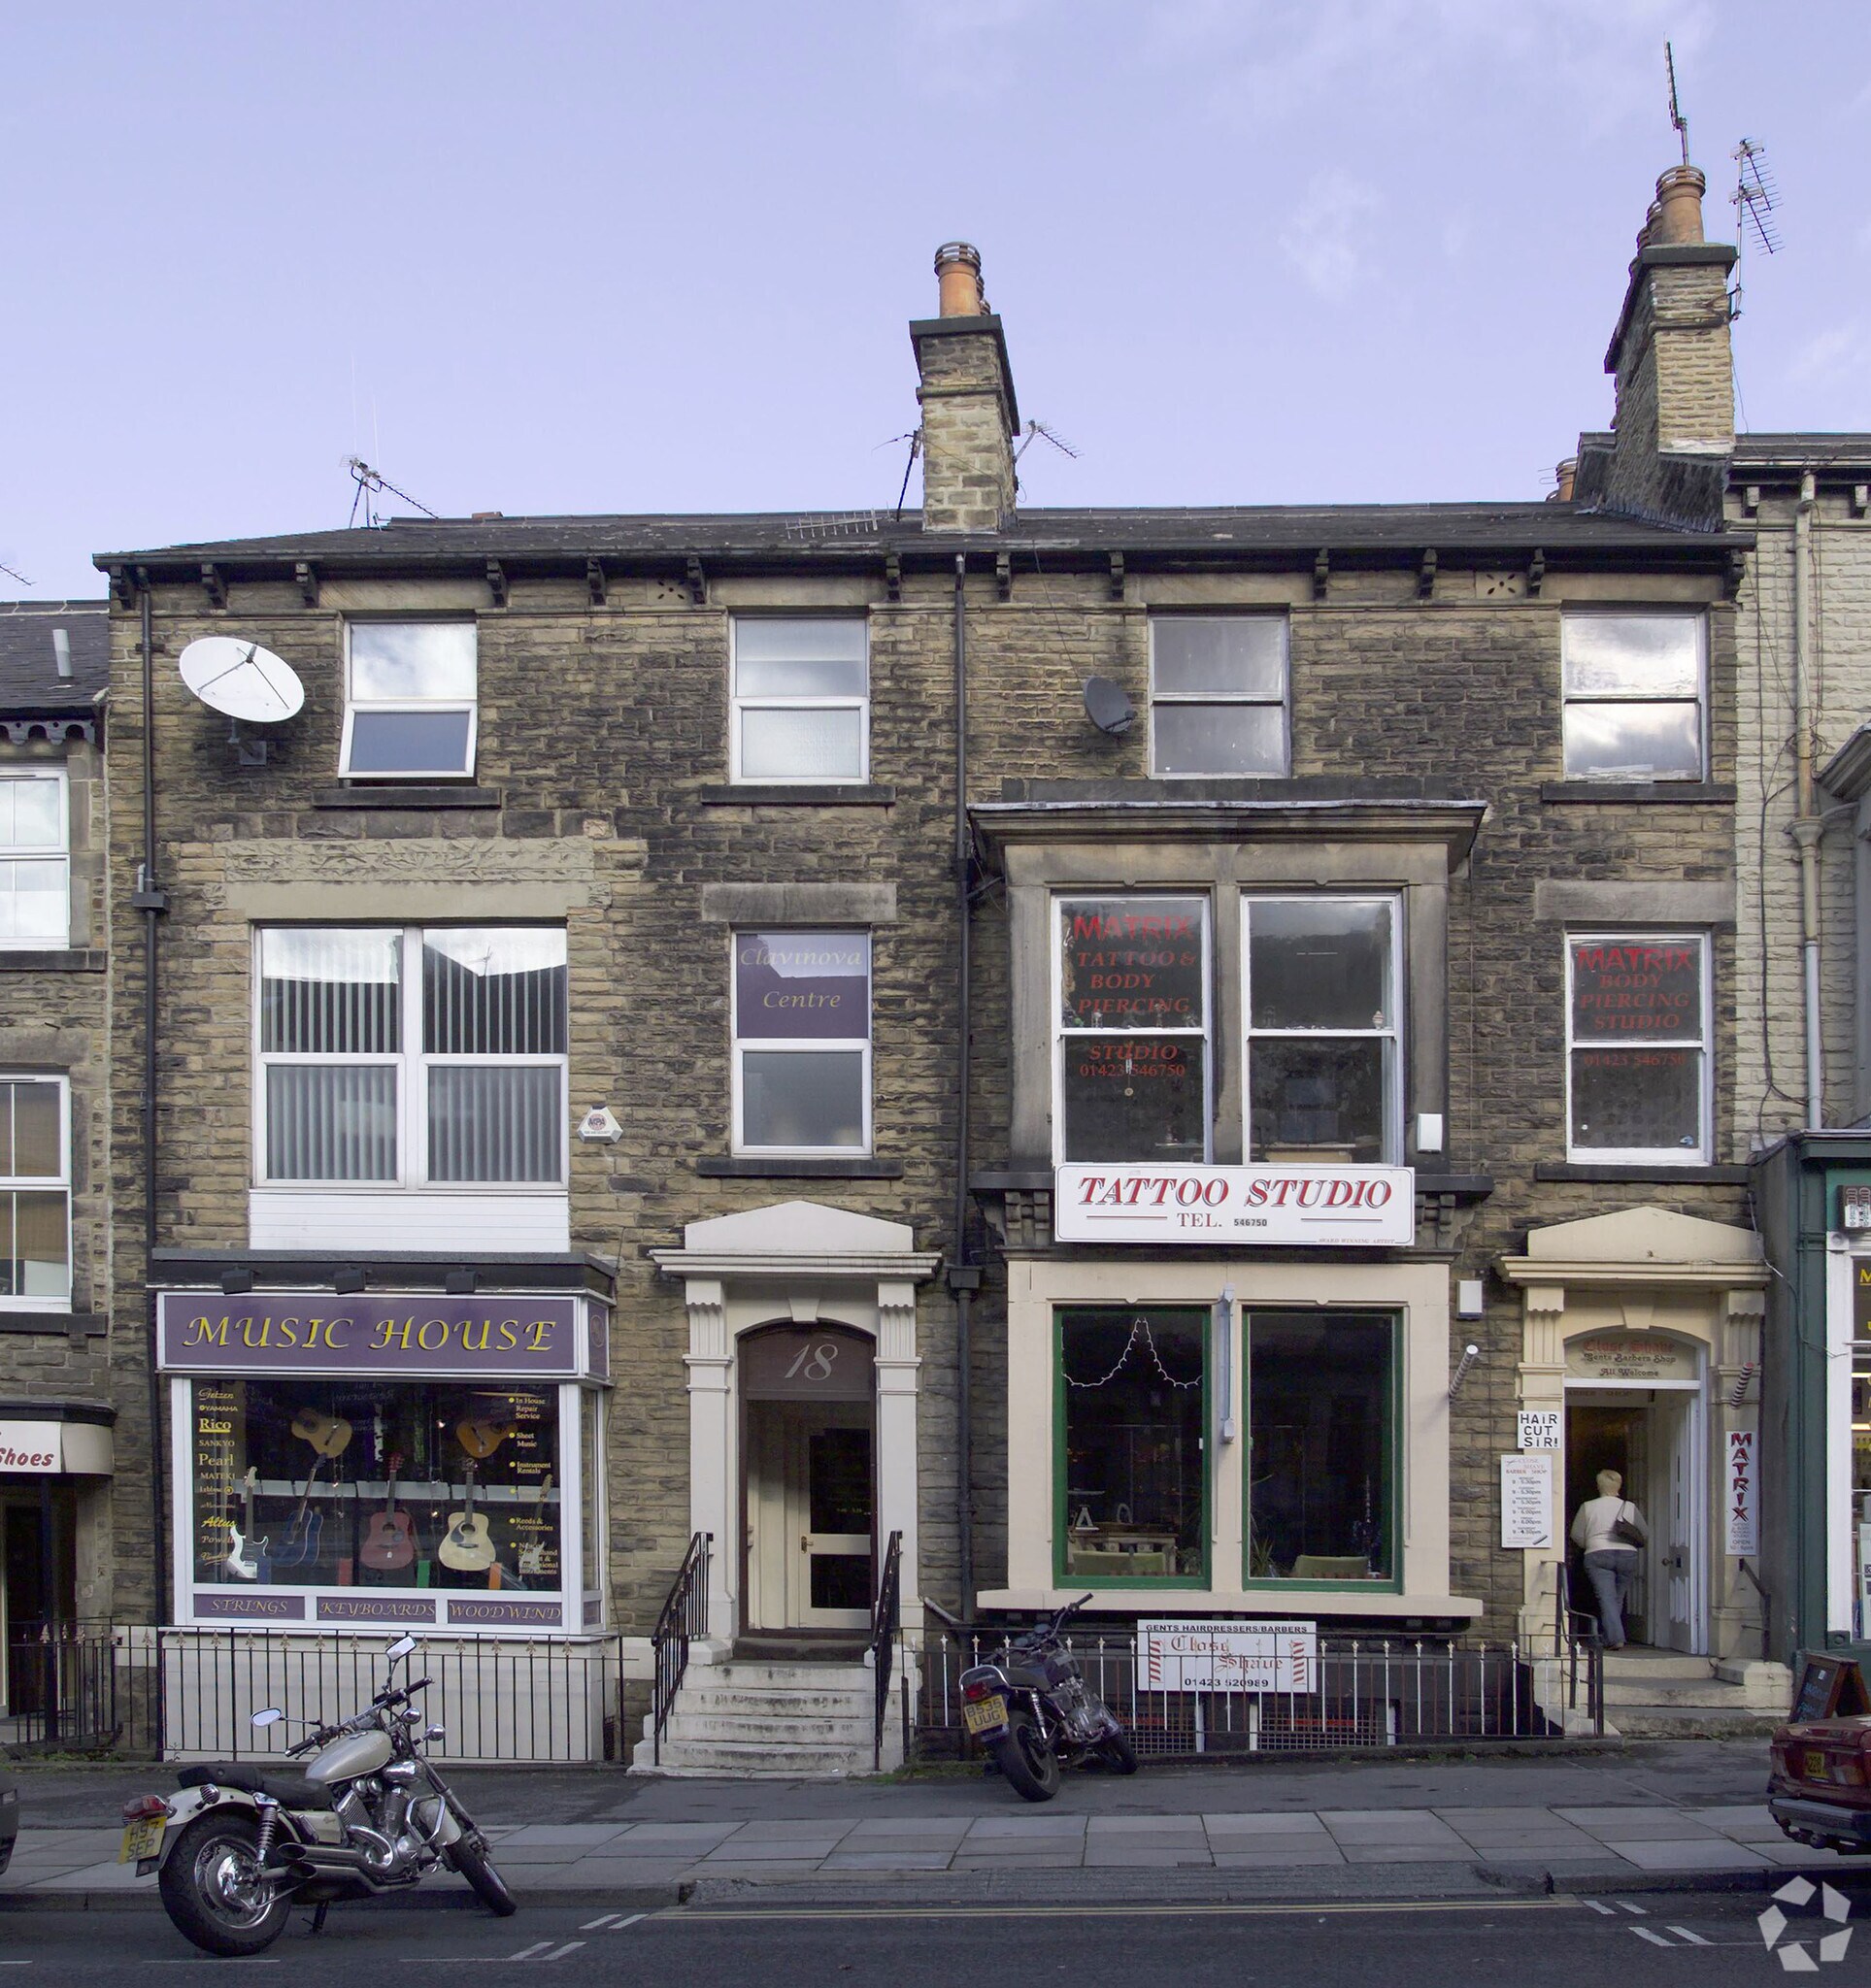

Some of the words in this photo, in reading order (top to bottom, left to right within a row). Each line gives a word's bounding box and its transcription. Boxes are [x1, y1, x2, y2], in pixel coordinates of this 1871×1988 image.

[1073, 915, 1194, 941] MATRIX
[740, 947, 862, 966] Clavinova
[1077, 951, 1175, 967] TATTOO
[1179, 954, 1195, 964] &
[1576, 947, 1693, 971] MATRIX
[1090, 974, 1155, 989] BODY
[1599, 974, 1663, 989] BODY
[763, 990, 841, 1008] Centre
[1077, 997, 1189, 1014] PIERCING
[1580, 992, 1689, 1009] PIERCING
[1594, 1014, 1680, 1029] STUDIO
[1088, 1044, 1178, 1060] STUDIO
[1080, 1064, 1125, 1077] 01423
[1077, 1176, 1229, 1207] TATTOO
[1244, 1178, 1392, 1209] STUDIO
[1177, 1212, 1222, 1228] TEL.
[1233, 1218, 1268, 1227] 546750
[183, 1315, 353, 1350] MUSIC
[368, 1315, 556, 1352] HOUSE
[785, 1343, 839, 1380] 18
[1654, 1354, 1676, 1364] Shop
[1600, 1368, 1617, 1376] All
[199, 1418, 232, 1429] Rico
[1523, 1425, 1553, 1436] CUT
[198, 1453, 234, 1466] Pearl
[1730, 1433, 1753, 1522] MATRIX
[201, 1515, 237, 1527] Altus
[211, 1599, 288, 1614] STRINGS
[319, 1602, 437, 1618] KEYBOARDS
[448, 1603, 561, 1620] WOODWIND
[1171, 1635, 1229, 1653] Close
[1185, 1678, 1221, 1687] 01423
